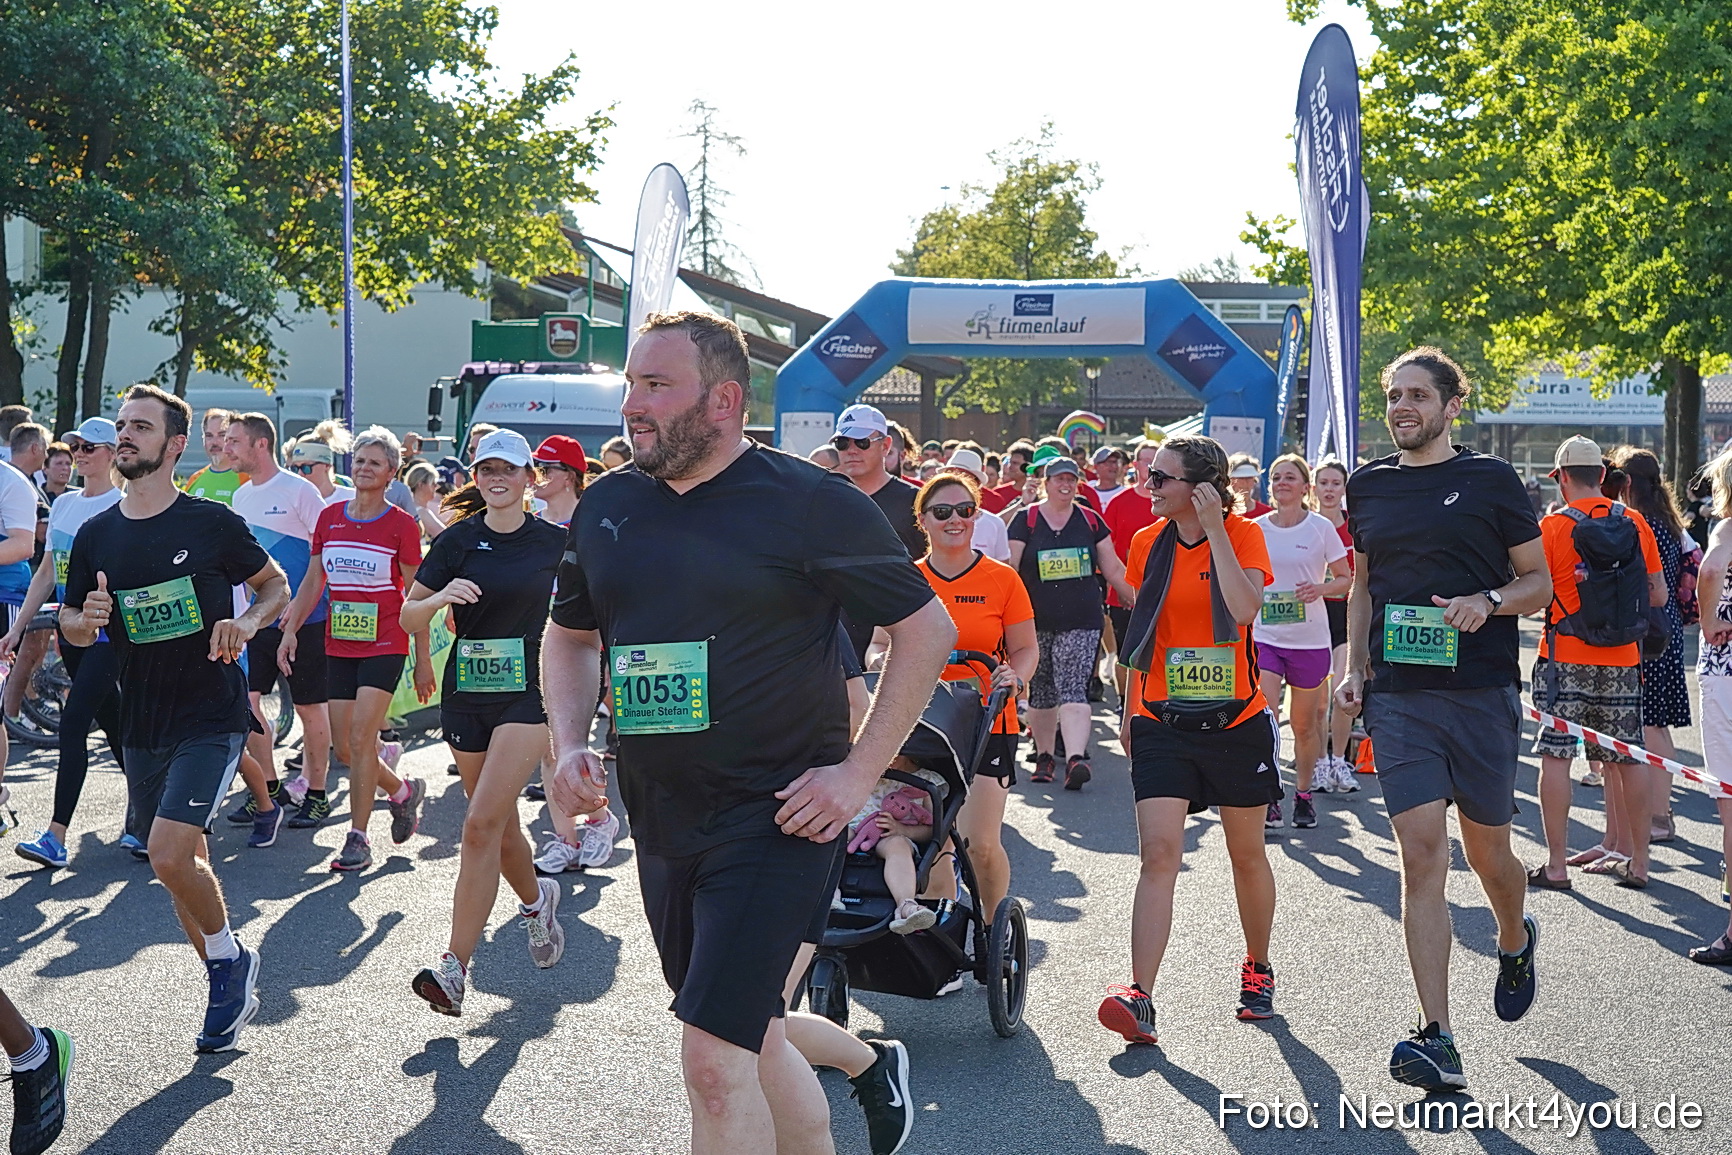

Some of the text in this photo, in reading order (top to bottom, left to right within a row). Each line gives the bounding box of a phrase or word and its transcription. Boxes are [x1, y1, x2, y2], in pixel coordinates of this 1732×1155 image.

[999, 316, 1087, 334] firmenlauf
[829, 342, 878, 354] Fischer
[334, 556, 377, 573] Petry
[1049, 558, 1069, 571] 291
[954, 595, 986, 604] THULE
[1270, 602, 1294, 615] 102
[133, 599, 185, 625] 1291
[186, 598, 199, 625] 2022
[337, 613, 369, 628] 1235
[126, 615, 138, 634] RUN
[155, 618, 191, 631] Alexander
[1395, 625, 1445, 646] 1058
[1446, 631, 1455, 658] 2022
[1414, 646, 1447, 655] Sebastian
[466, 657, 513, 675] 1054
[514, 659, 522, 684] 2022
[1176, 665, 1223, 683] 1408
[622, 674, 688, 705] 1053
[691, 677, 703, 719] 2022
[615, 687, 623, 717] RUN
[624, 706, 689, 717] Dinauer Stefan
